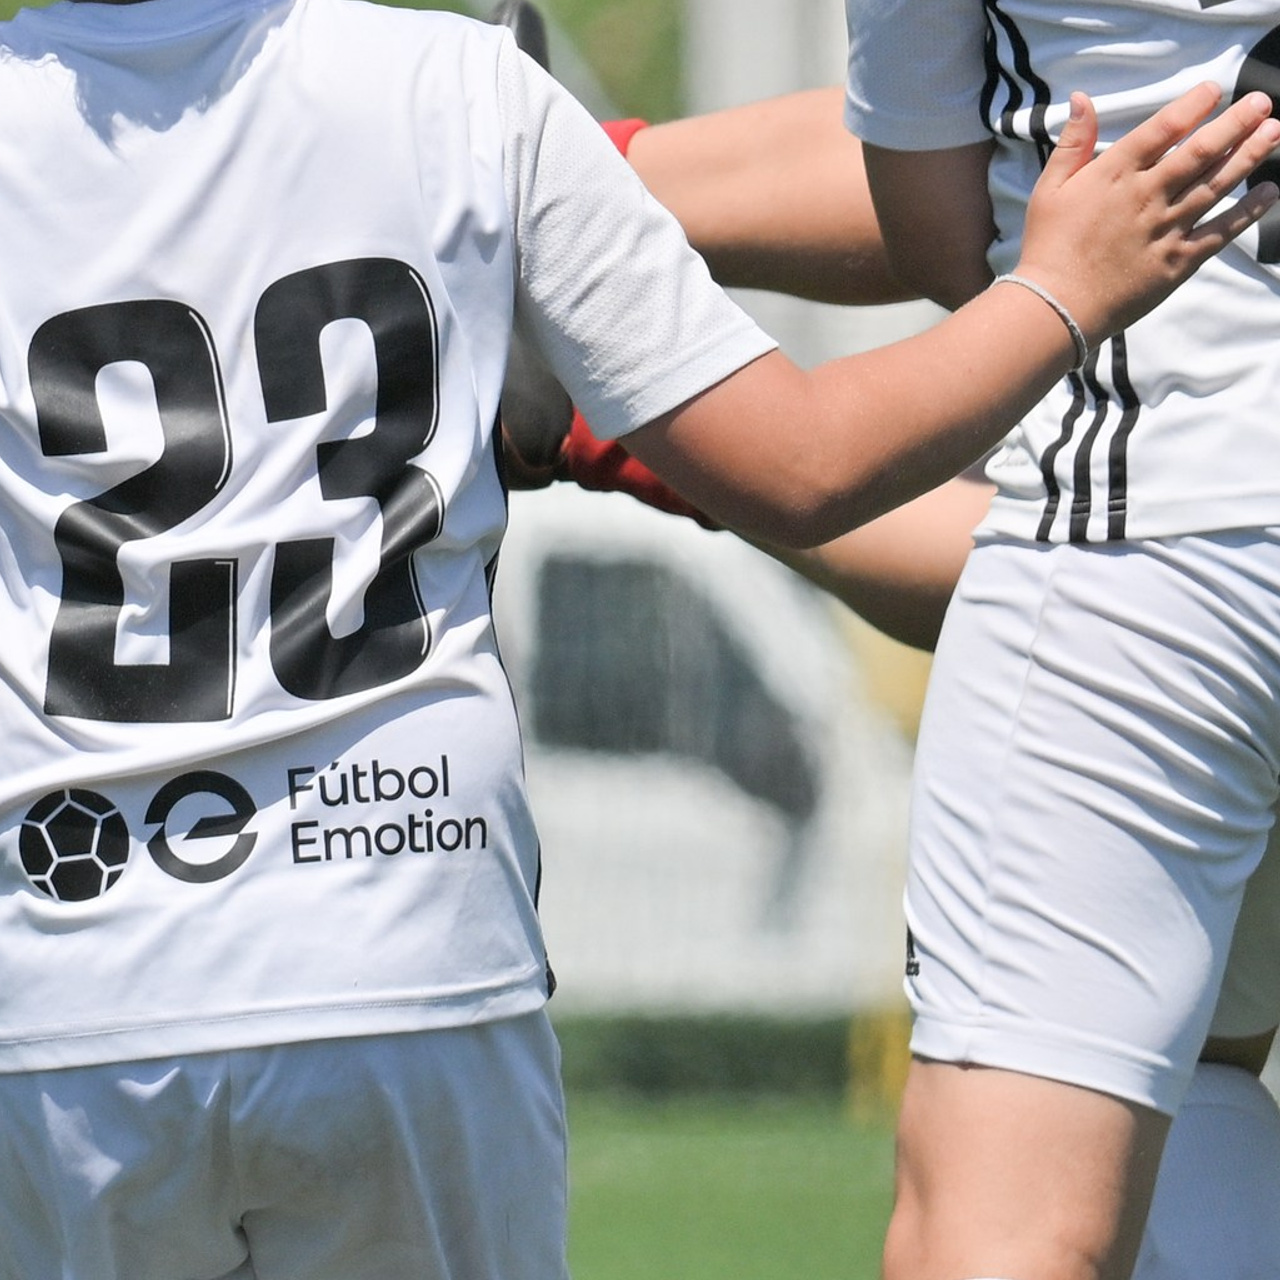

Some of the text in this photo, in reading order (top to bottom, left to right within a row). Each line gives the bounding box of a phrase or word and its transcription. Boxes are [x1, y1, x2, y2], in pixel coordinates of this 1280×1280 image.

[27, 256, 445, 724] 23
[287, 754, 450, 810] Fútbol
[291, 808, 488, 864] Emotion
